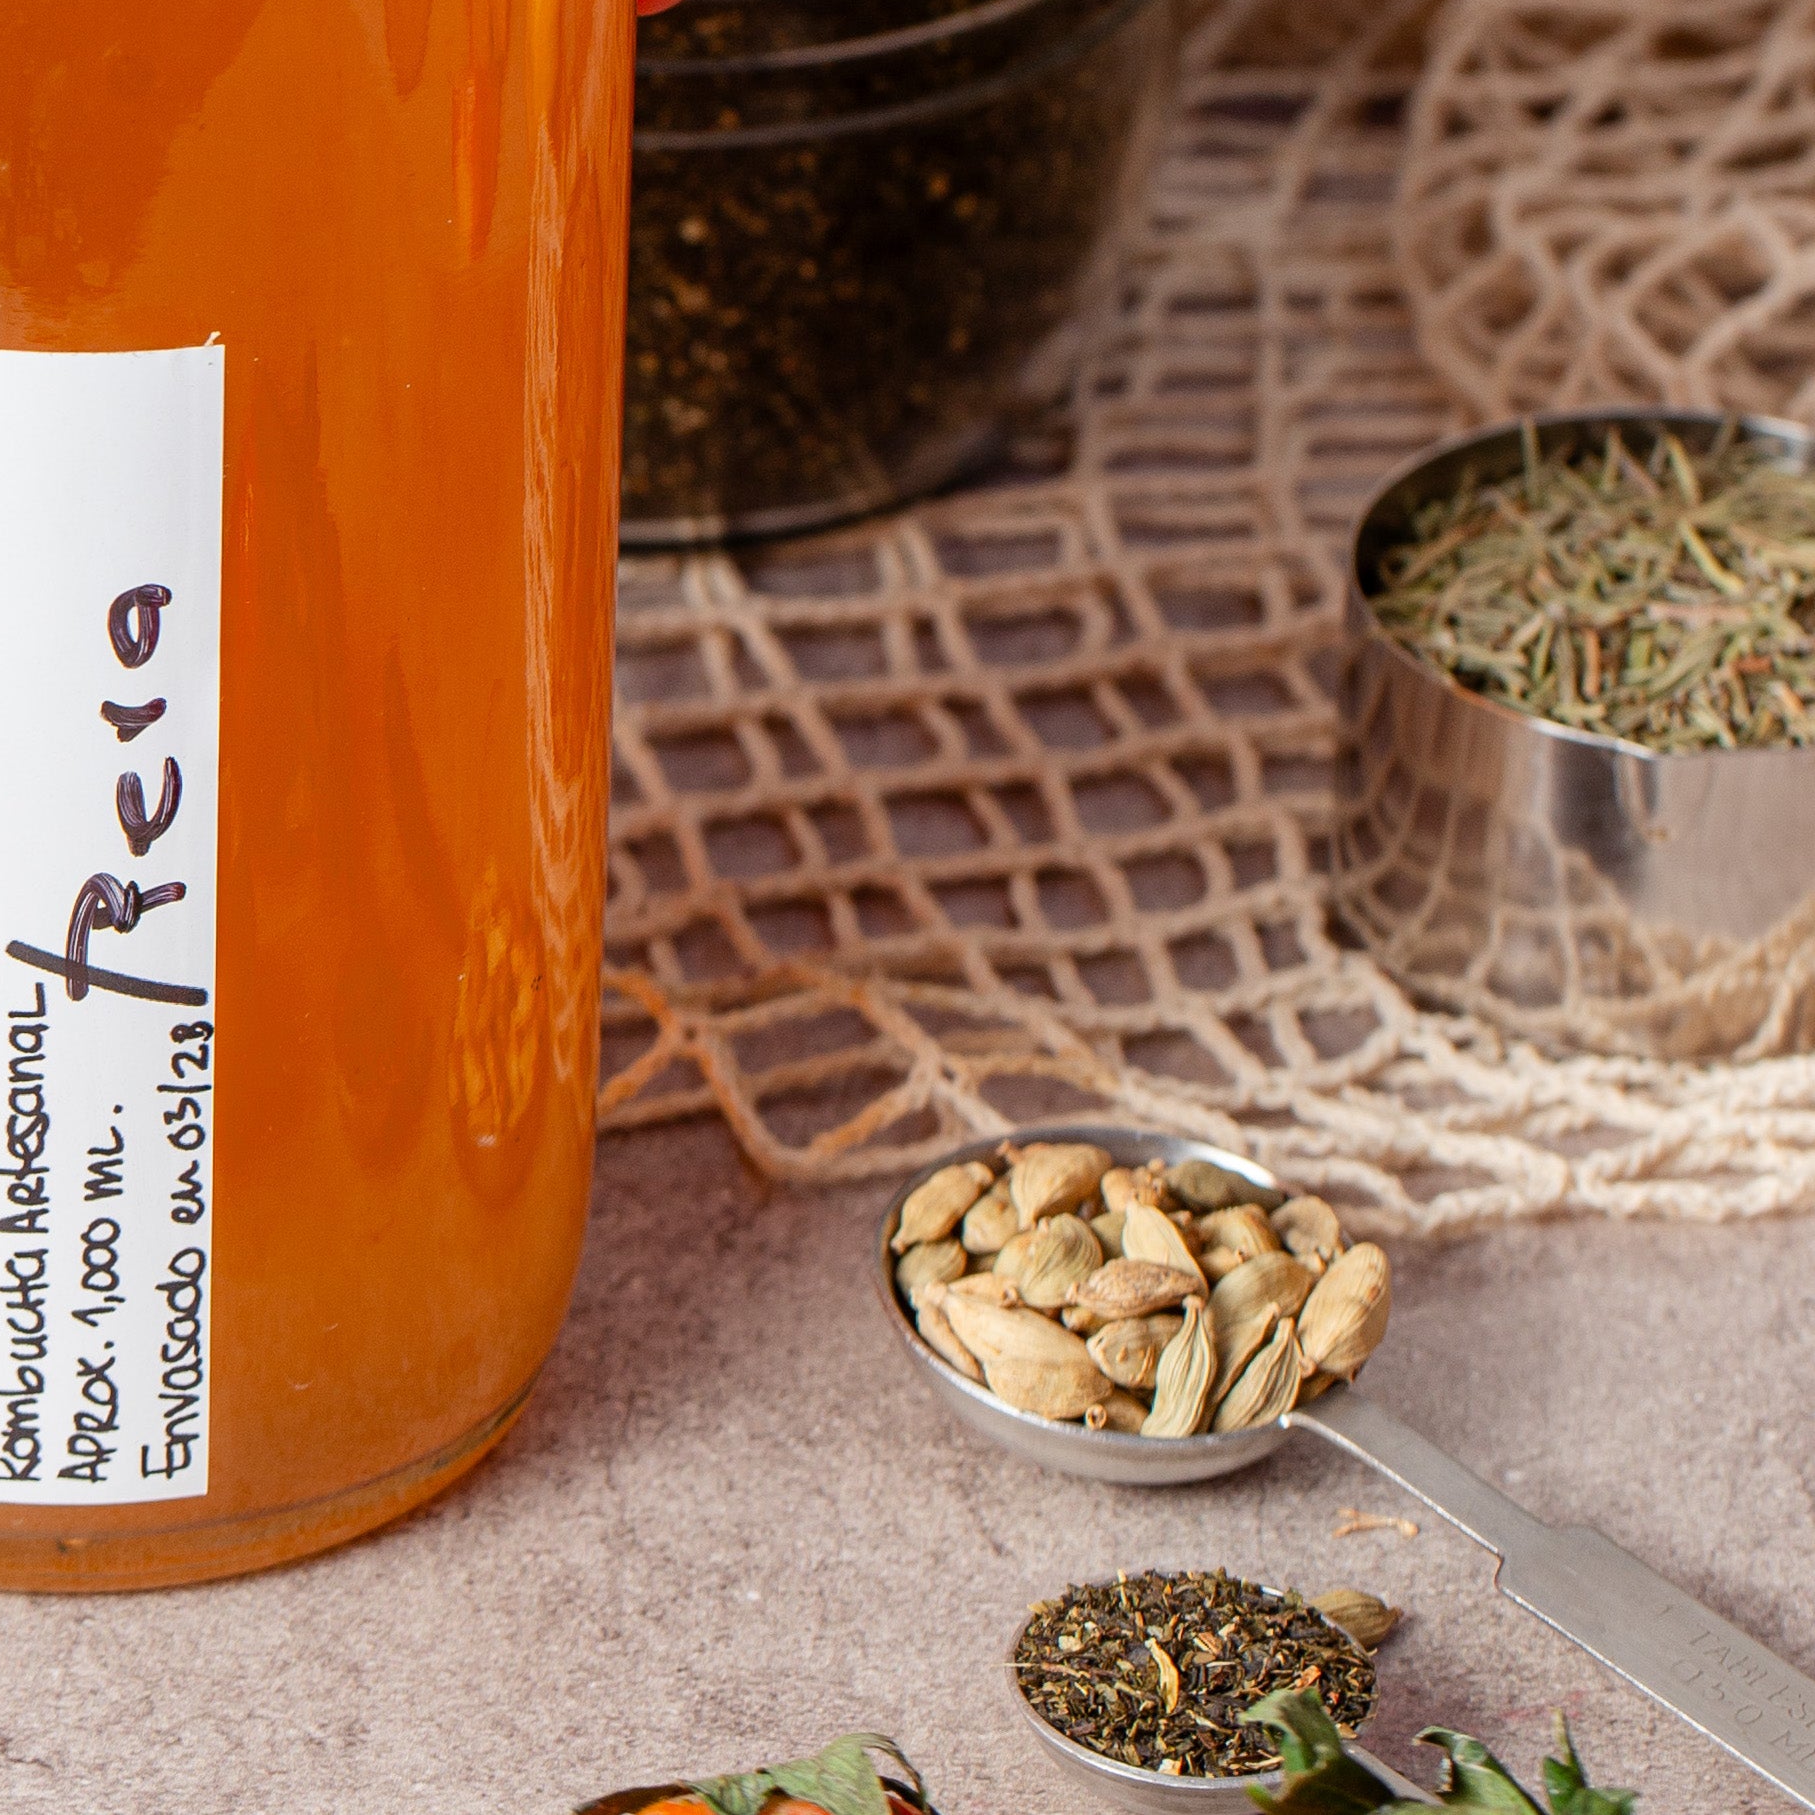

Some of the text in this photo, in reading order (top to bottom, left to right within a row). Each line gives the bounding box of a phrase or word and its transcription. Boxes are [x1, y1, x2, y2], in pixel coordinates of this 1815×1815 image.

[169, 1160, 206, 1226] en
[70, 1216, 127, 1329] 1,000
[140, 1246, 208, 1481] Envasado
